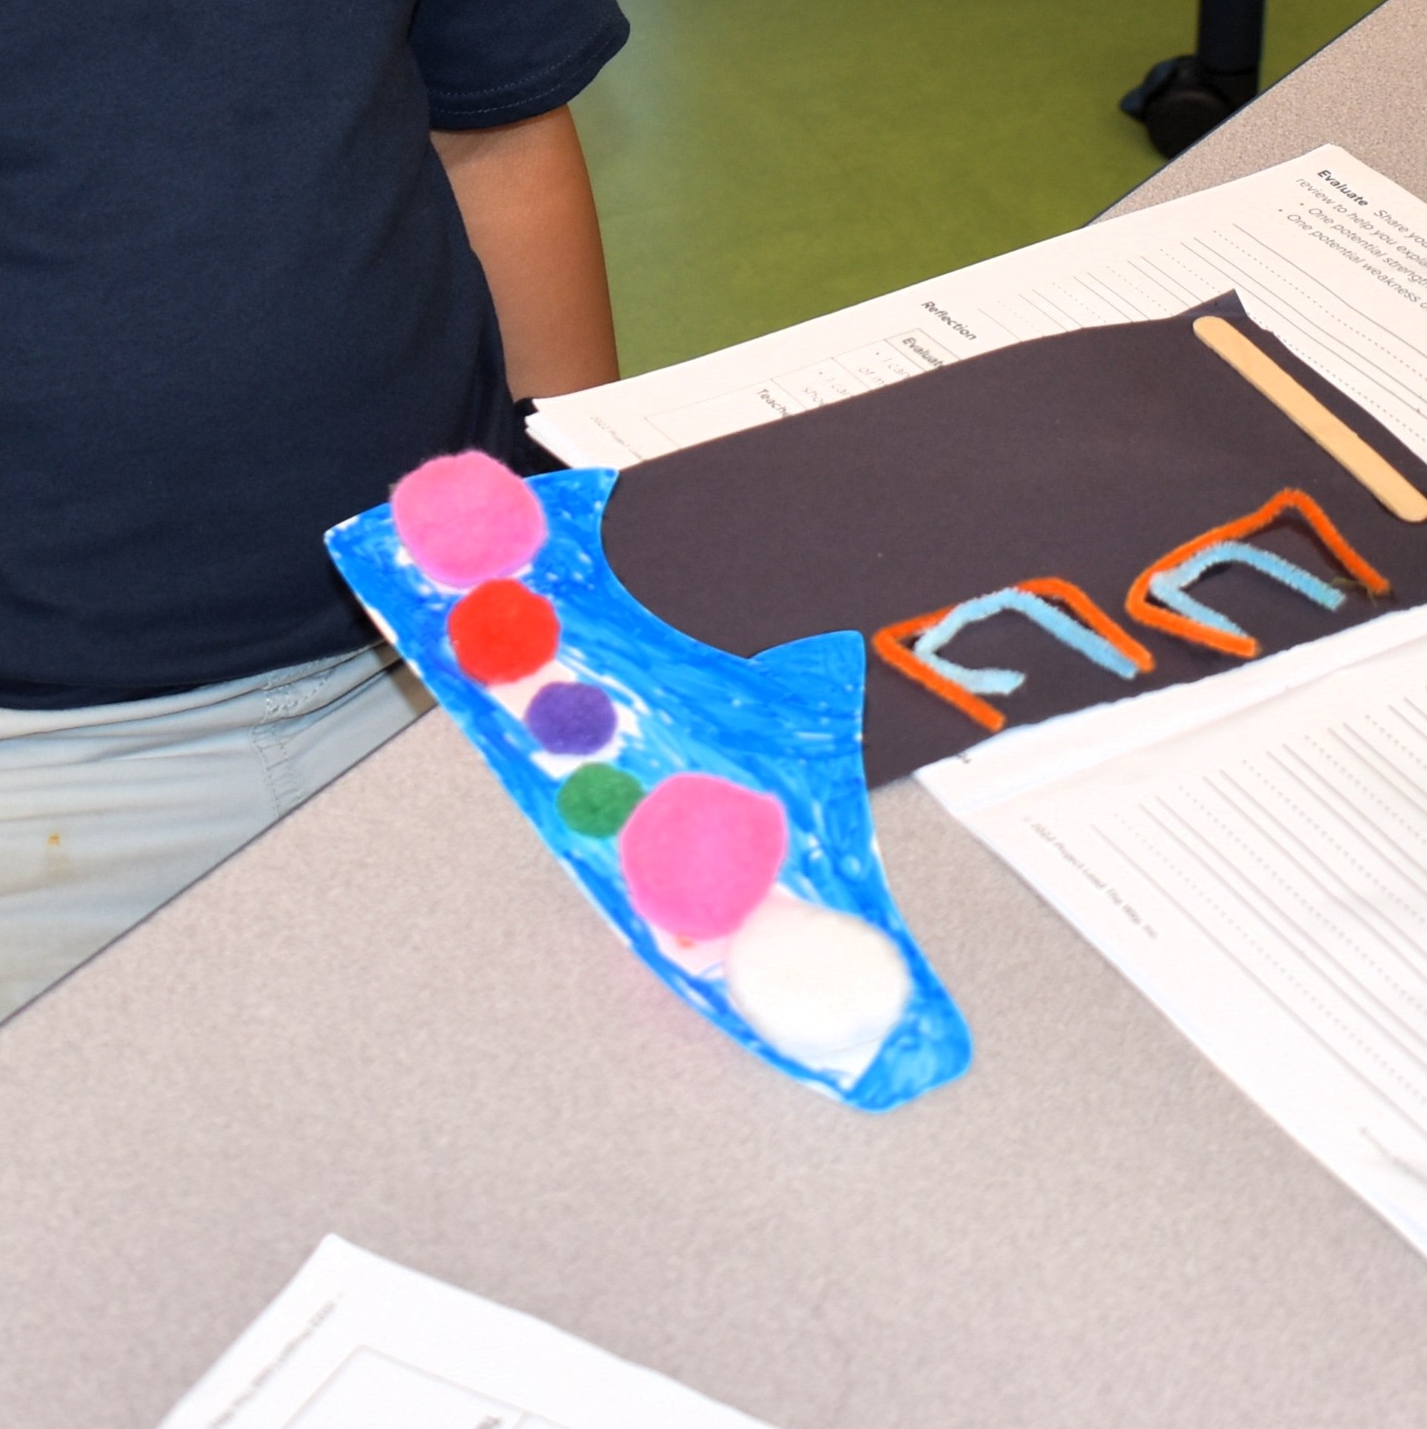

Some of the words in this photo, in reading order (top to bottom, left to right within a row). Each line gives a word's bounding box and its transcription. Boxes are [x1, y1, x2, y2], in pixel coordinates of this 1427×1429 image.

[1295, 178, 1336, 205] review
[1332, 203, 1348, 214] to
[1346, 212, 1375, 231] help
[1369, 229, 1398, 246] you
[1316, 169, 1369, 207] Evaluate
[1373, 209, 1410, 233] Share
[1286, 213, 1313, 231] One
[1308, 230, 1367, 264] potential
[1361, 263, 1422, 303] weakness
[1307, 207, 1335, 224] One
[1329, 223, 1388, 258] potential
[921, 301, 977, 341] Reflection
[902, 337, 945, 368] Evaluat
[757, 388, 790, 417] Teach
